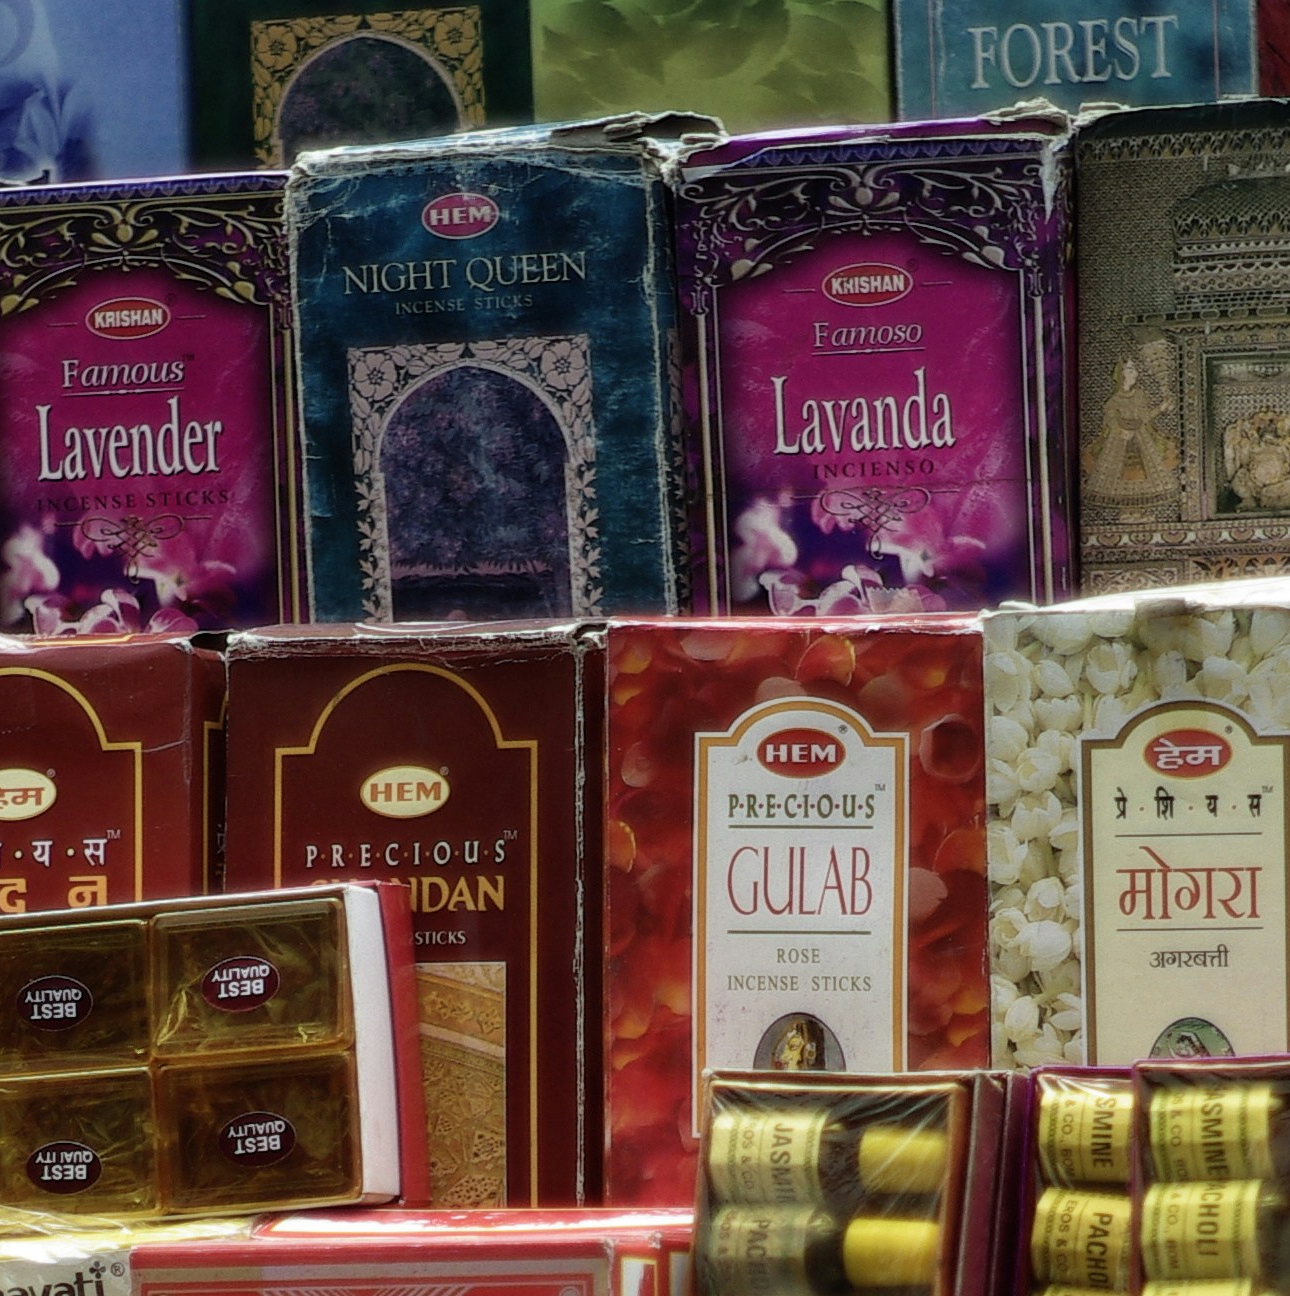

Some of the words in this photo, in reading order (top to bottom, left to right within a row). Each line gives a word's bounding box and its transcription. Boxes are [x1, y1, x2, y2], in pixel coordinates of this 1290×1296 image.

[969, 15, 1178, 90] FOREST
[428, 206, 493, 227] HEM
[342, 260, 459, 295] NIGHT
[464, 252, 588, 287] QUEEN
[829, 271, 906, 294] KRISHAN
[93, 304, 164, 330] KRISHAN
[395, 298, 466, 315] INCENSE
[473, 294, 535, 312] STICKS
[812, 322, 923, 350] Famoso
[61, 357, 185, 388] Famous
[771, 369, 956, 455] Lavanda
[35, 395, 223, 482] Lavender
[812, 459, 936, 480] INCIENSO
[36, 490, 137, 513] INCENSE
[147, 488, 229, 508] STICKS
[765, 743, 837, 764] HEM
[1152, 738, 1223, 770] हेम
[370, 782, 442, 803] HEM
[726, 844, 874, 917] GULAB
[1115, 845, 1264, 920] मोगरा
[414, 929, 467, 946] STICKS
[776, 948, 821, 964] ROSE
[1149, 943, 1231, 970] अगरबत्ती
[211, 963, 271, 984] QUALITY
[726, 975, 800, 992] INCENSE
[811, 975, 872, 992] STICKS
[217, 977, 266, 998] BEST
